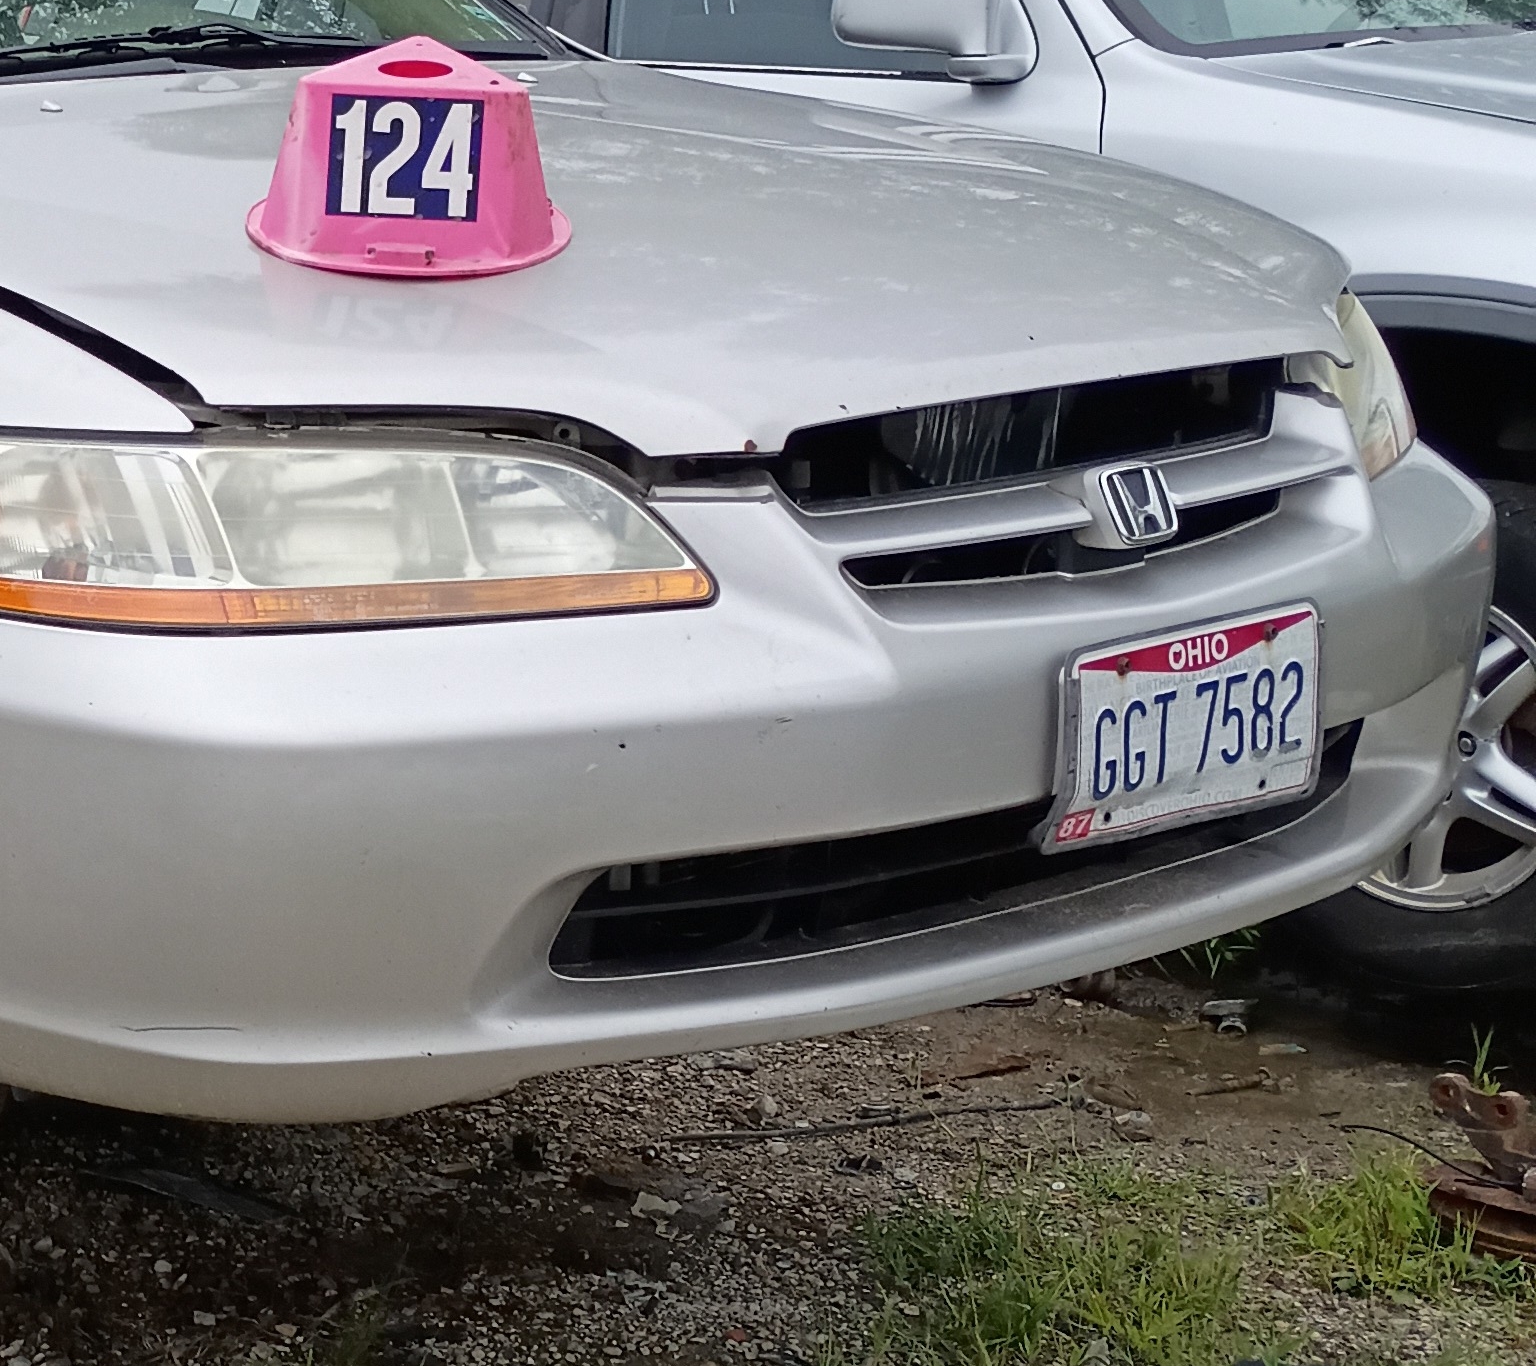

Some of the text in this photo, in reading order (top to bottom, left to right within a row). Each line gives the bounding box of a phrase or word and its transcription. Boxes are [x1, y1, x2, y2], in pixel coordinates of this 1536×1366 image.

[335, 98, 474, 218] 124
[1167, 632, 1229, 671] OHIO
[1215, 655, 1261, 678] AVIATION
[1092, 660, 1304, 801] GGT 7582
[1060, 812, 1092, 838] 87
